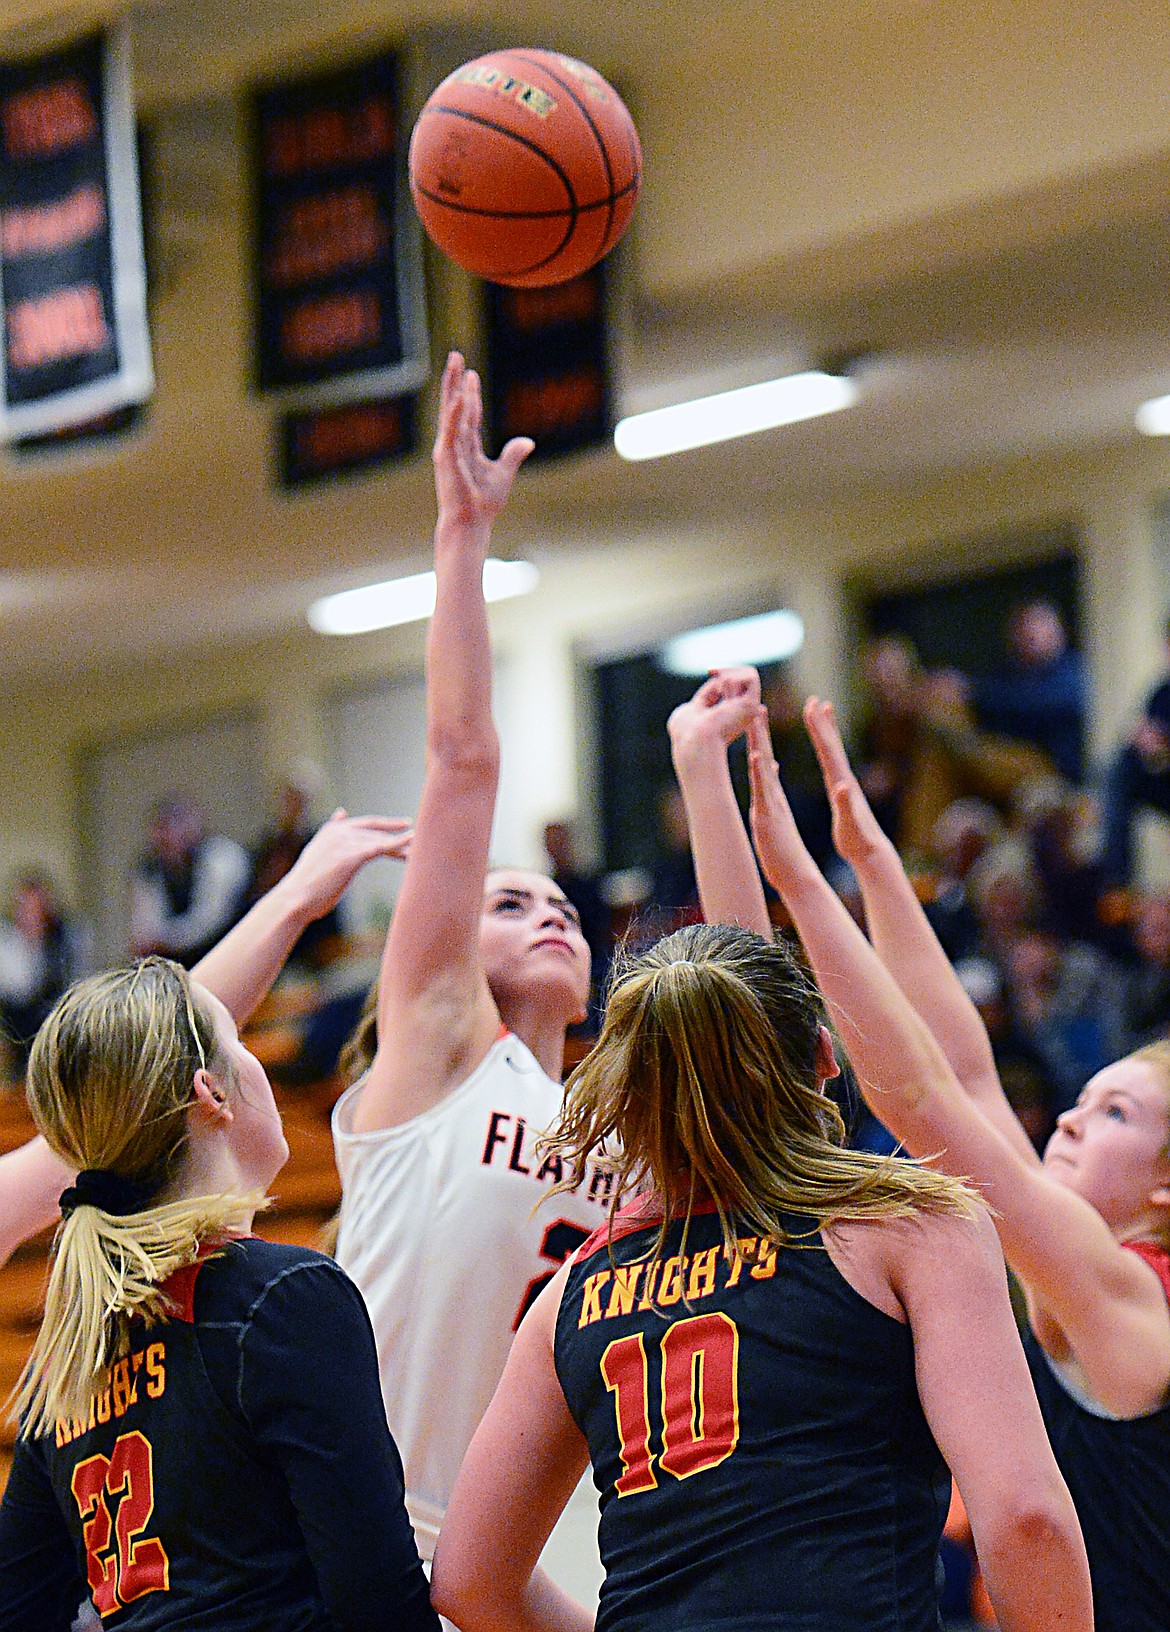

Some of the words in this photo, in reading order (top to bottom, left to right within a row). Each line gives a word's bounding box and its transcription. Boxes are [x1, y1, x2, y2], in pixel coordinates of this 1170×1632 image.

[578, 1236, 777, 1329] KNIGHTS
[600, 1311, 739, 1499] 10
[71, 1430, 170, 1618] 22
